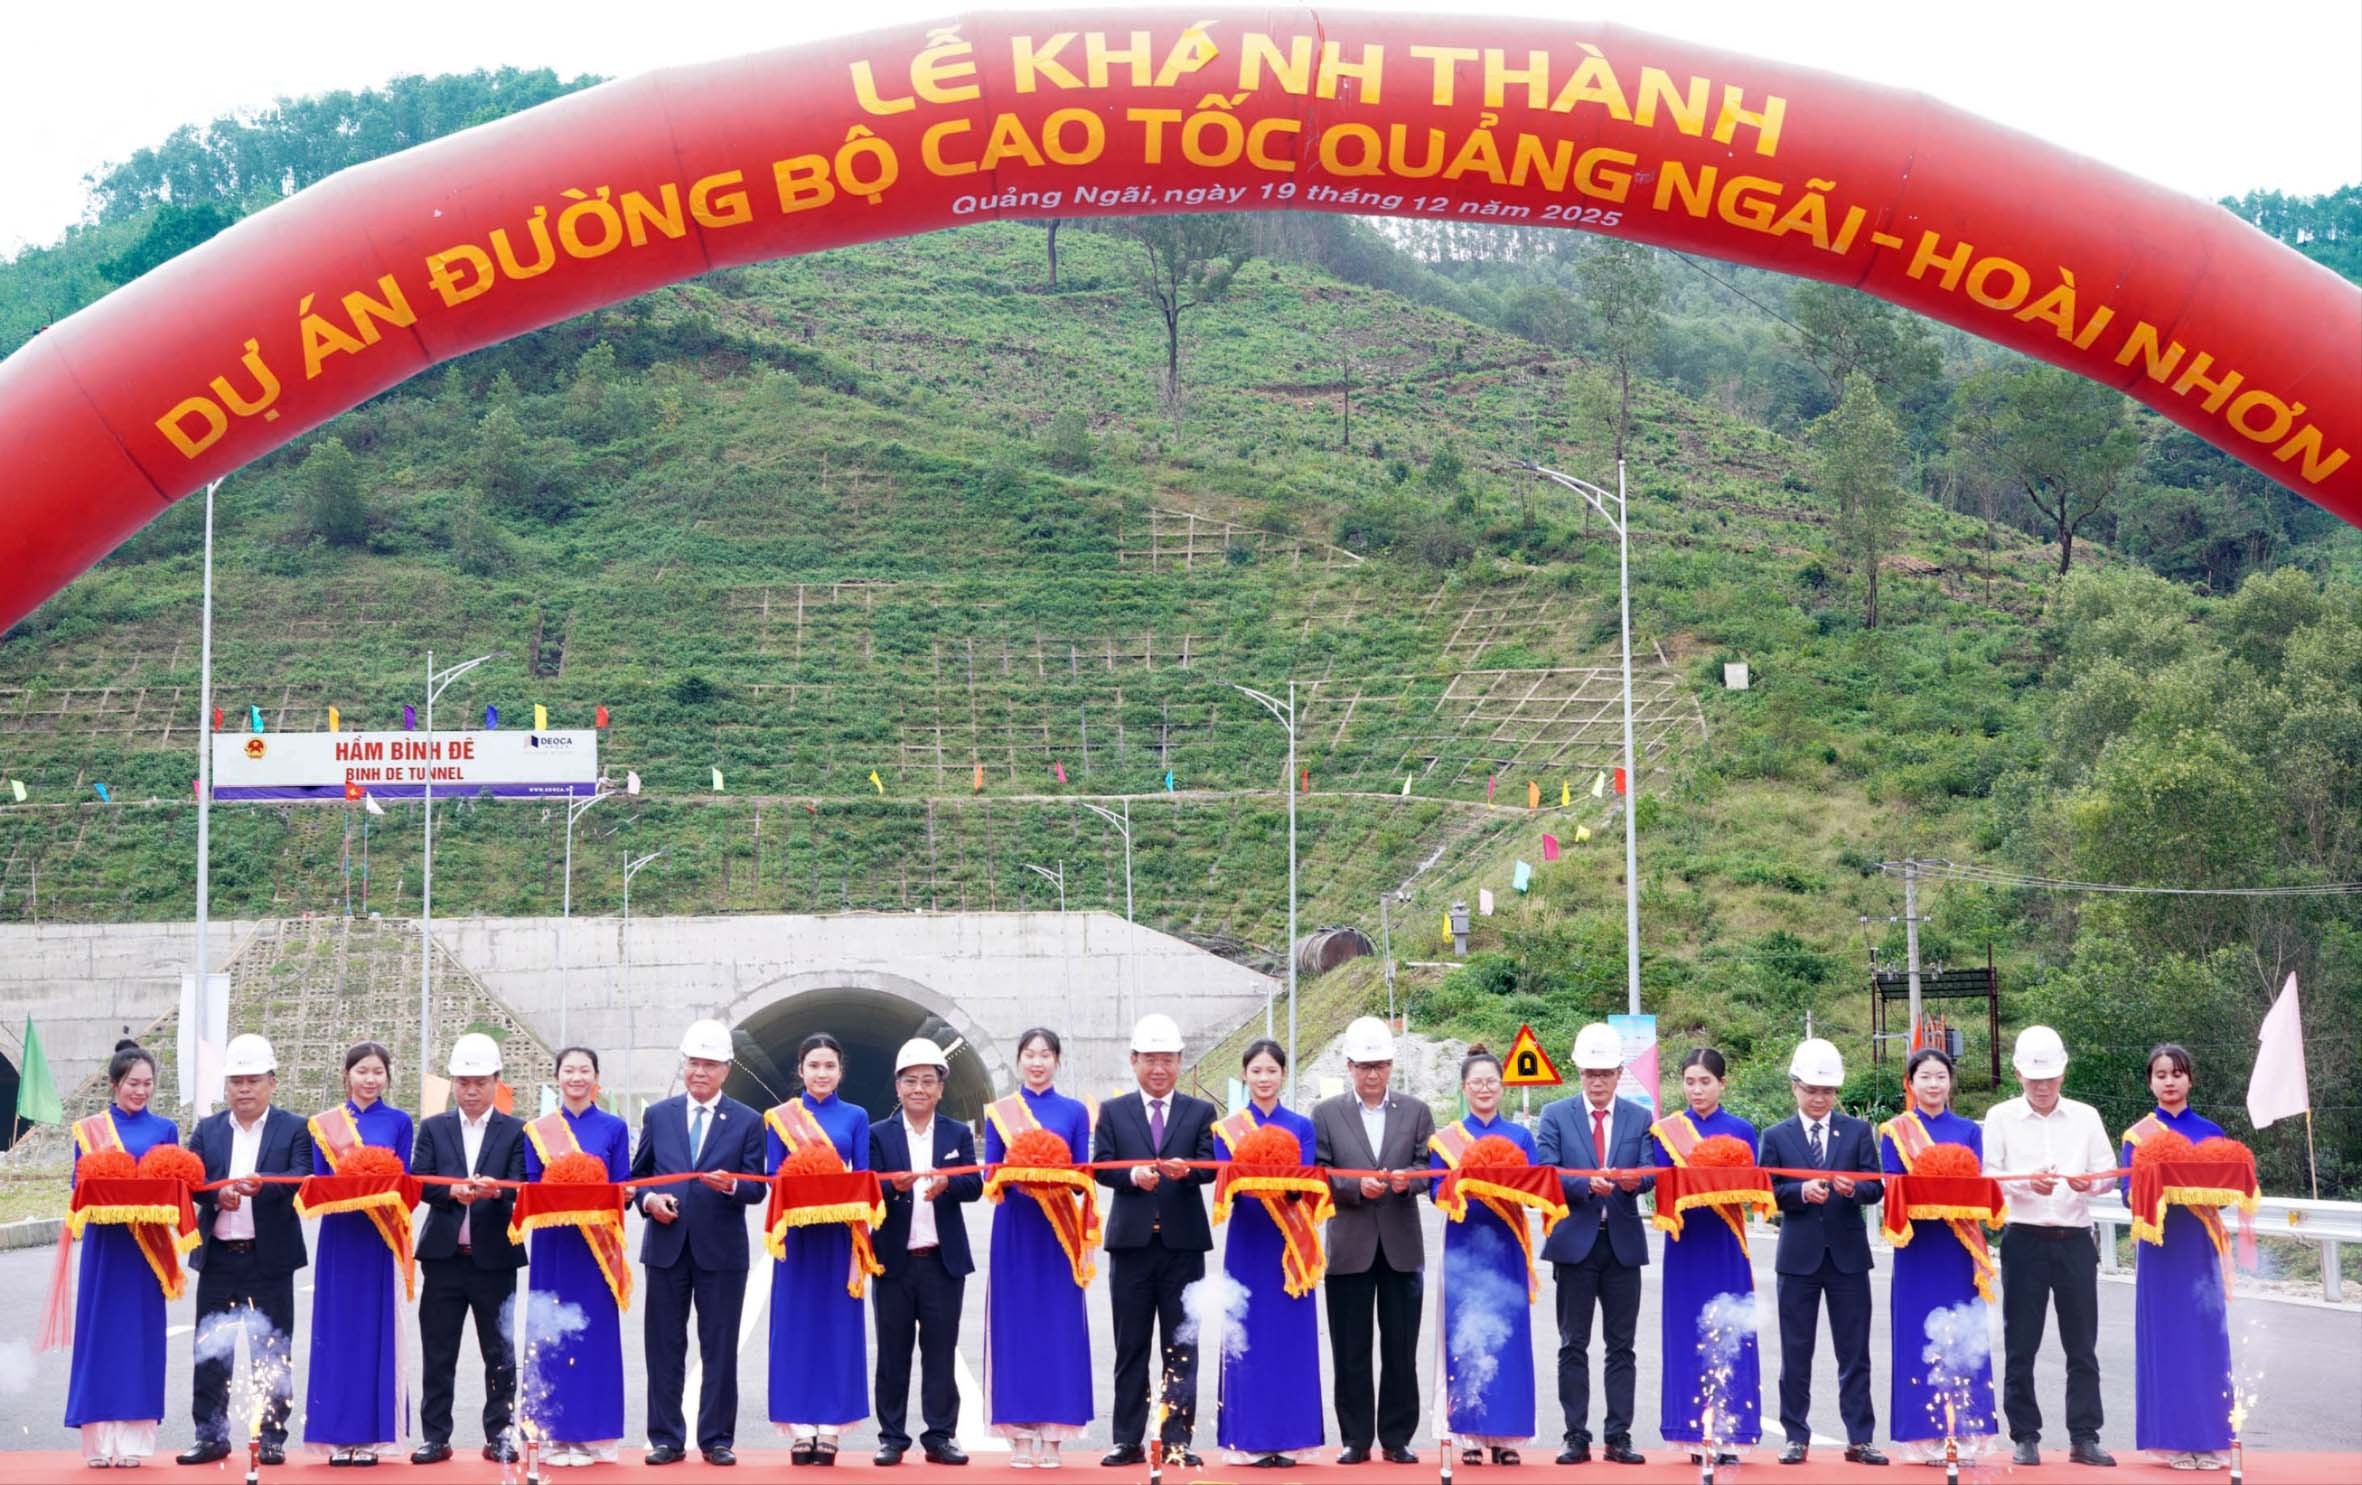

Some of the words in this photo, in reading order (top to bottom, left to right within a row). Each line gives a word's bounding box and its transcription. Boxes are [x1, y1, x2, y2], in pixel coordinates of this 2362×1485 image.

[849, 24, 981, 116] LỄ
[1012, 19, 1385, 105] KHÁNH
[1410, 41, 1787, 158] THÀNH
[952, 187, 1062, 215] Quảng
[1260, 182, 1297, 200] 19
[1306, 185, 1402, 210] tháng
[1413, 196, 1449, 212] 12
[1458, 199, 1531, 218] năm
[1540, 204, 1623, 227] 2025
[155, 338, 281, 459] DỰ
[299, 273, 417, 379] ÁN
[427, 169, 754, 308] ĐƯỜNG
[773, 123, 899, 214] BỘ
[921, 107, 1105, 177] CAO
[1127, 91, 1303, 174] TỐC
[1319, 112, 1637, 204] QUẢNG
[2114, 320, 2351, 485] NHƠN
[335, 735, 384, 761] HẦM
[391, 737, 441, 760] BÌNH
[541, 737, 573, 745] DEOCA
[345, 768, 380, 780] BINH
[386, 768, 403, 780] DE
